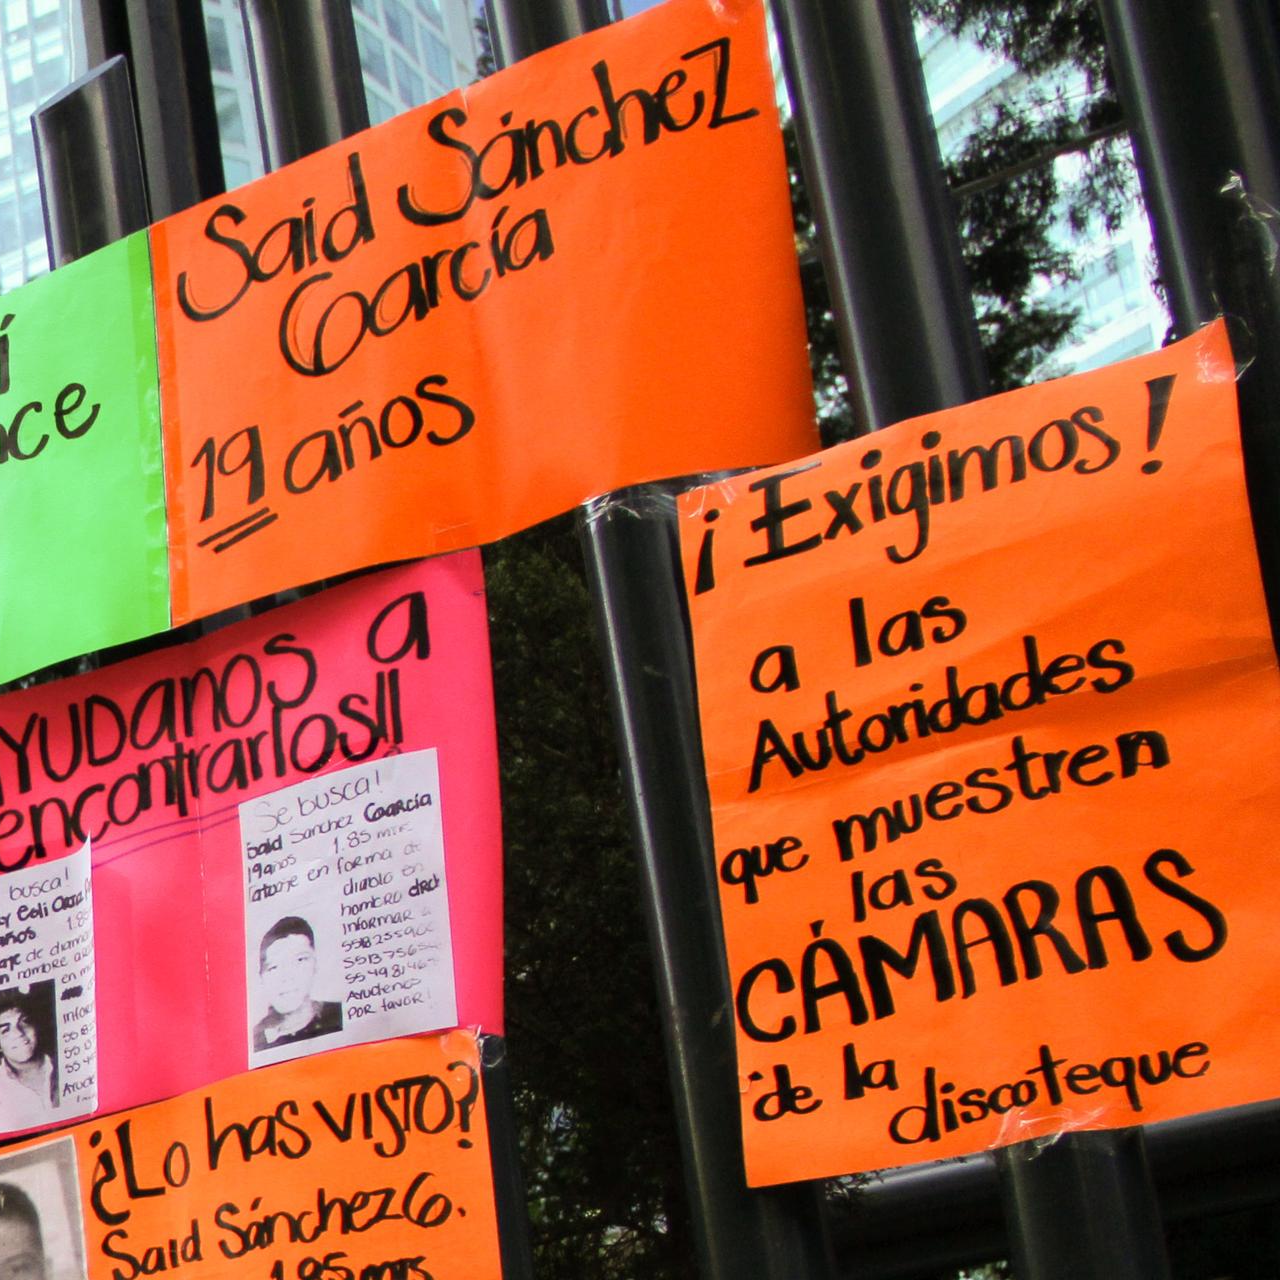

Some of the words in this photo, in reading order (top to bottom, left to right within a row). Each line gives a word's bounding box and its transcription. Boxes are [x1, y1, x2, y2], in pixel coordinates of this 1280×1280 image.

[191, 426, 265, 522] 19
[284, 375, 474, 494] años
[749, 645, 800, 695] a
[849, 596, 967, 669] las
[747, 636, 1134, 792] Autoridades
[722, 836, 808, 904] que
[833, 730, 1170, 861] muestren
[737, 849, 1227, 1043] CÁMARAS
[851, 858, 957, 922] las
[205, 1098, 311, 1170] has
[751, 1066, 823, 1122] de
[842, 1043, 897, 1099] la
[888, 1036, 1211, 1144] discoteque
